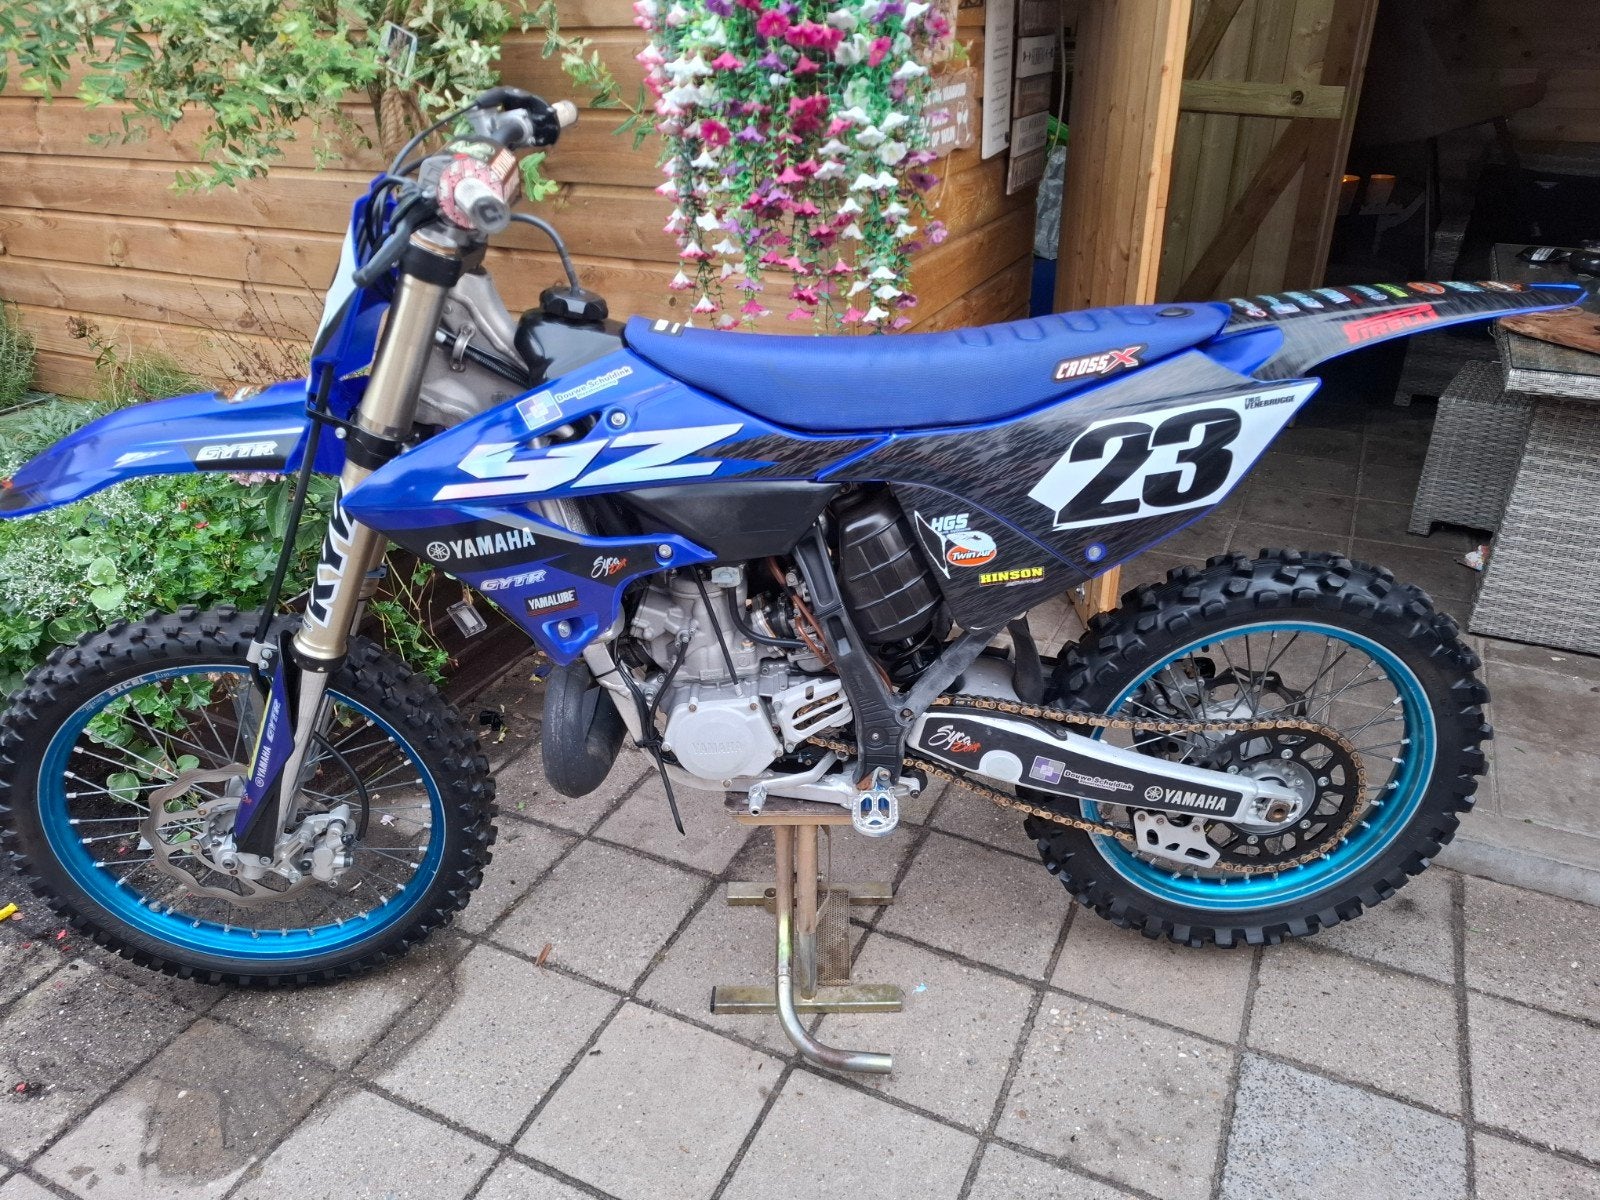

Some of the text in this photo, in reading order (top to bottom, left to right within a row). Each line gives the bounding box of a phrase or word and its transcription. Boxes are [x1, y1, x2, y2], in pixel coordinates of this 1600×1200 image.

[195, 441, 278, 461] GYTR
[1057, 407, 1242, 524] 23
[931, 513, 970, 531] HGS
[449, 527, 536, 559] YAMAHA
[951, 550, 976, 561] Twin
[480, 569, 547, 591] GYTR
[980, 567, 1043, 584] HINSON
[527, 589, 577, 610] YAMALUBE
[256, 745, 272, 778] YAMAHA
[1093, 777, 1133, 791] Schuldink
[1164, 788, 1227, 812] YAMAHA
